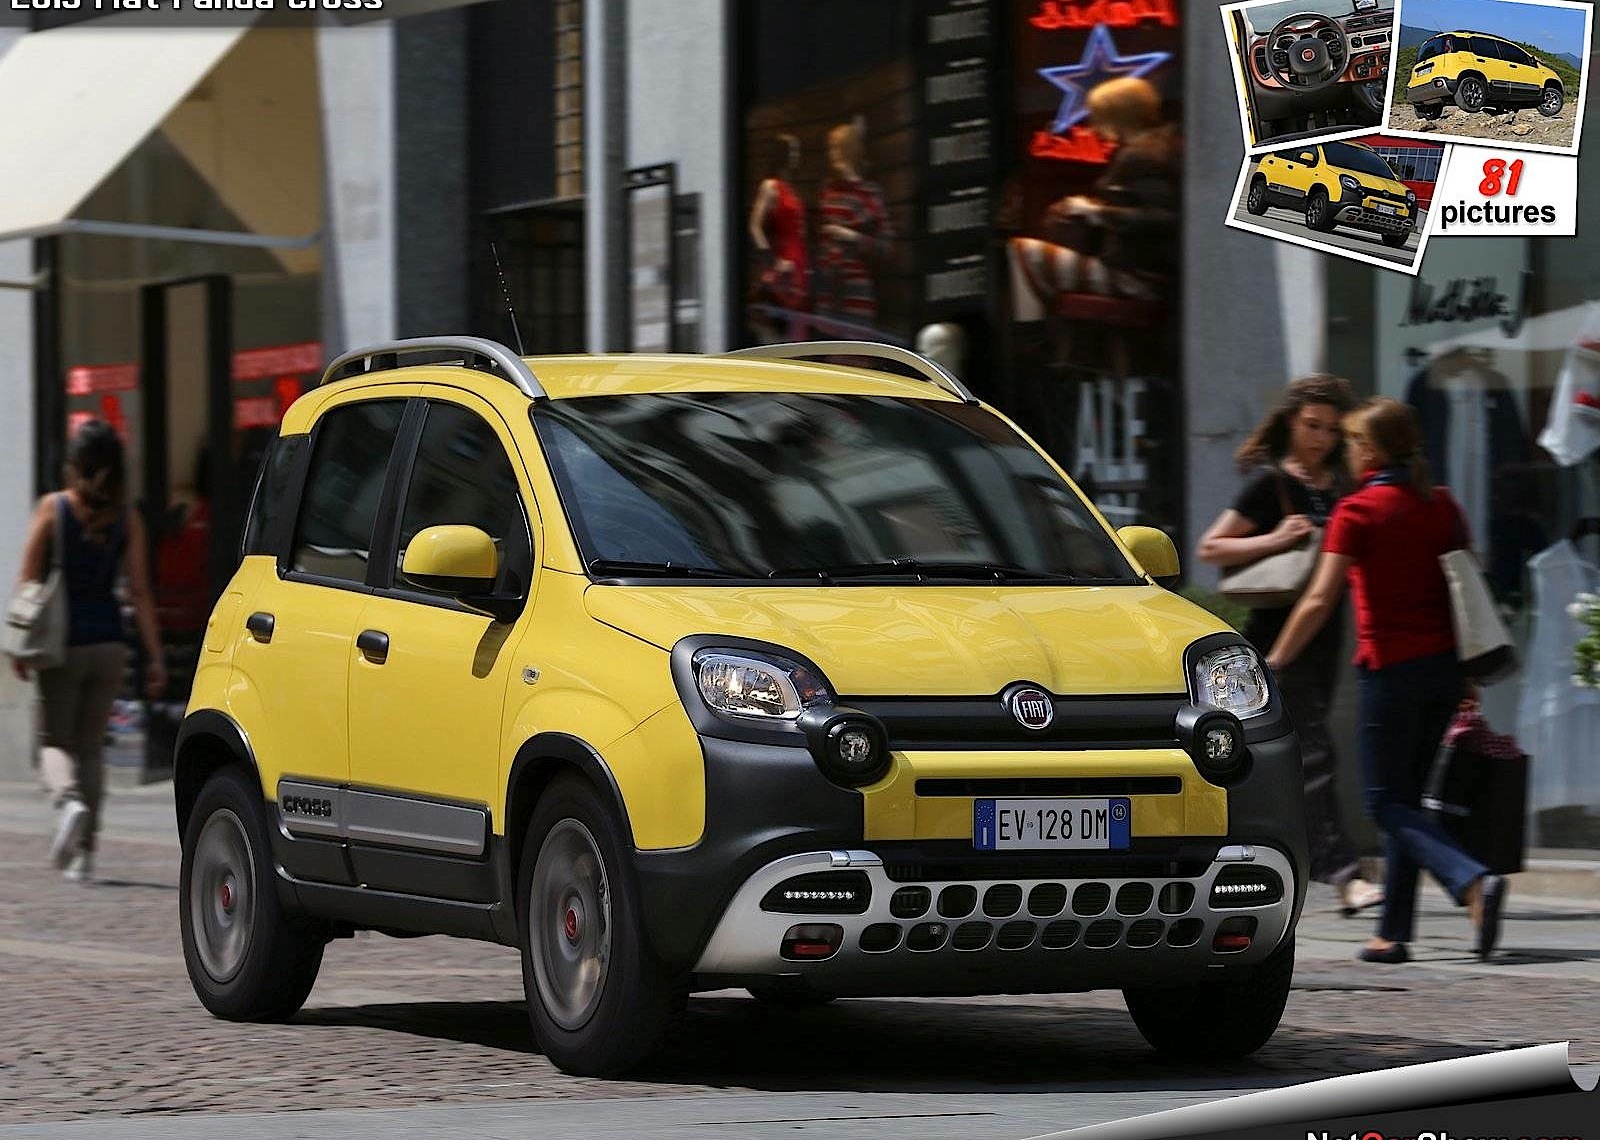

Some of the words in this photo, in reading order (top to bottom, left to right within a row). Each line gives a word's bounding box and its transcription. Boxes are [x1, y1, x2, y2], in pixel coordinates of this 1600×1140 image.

[1021, 700, 1045, 718] FIAT
[999, 809, 1026, 840] EV
[1036, 809, 1073, 840] 128
[1081, 808, 1107, 839] DM
